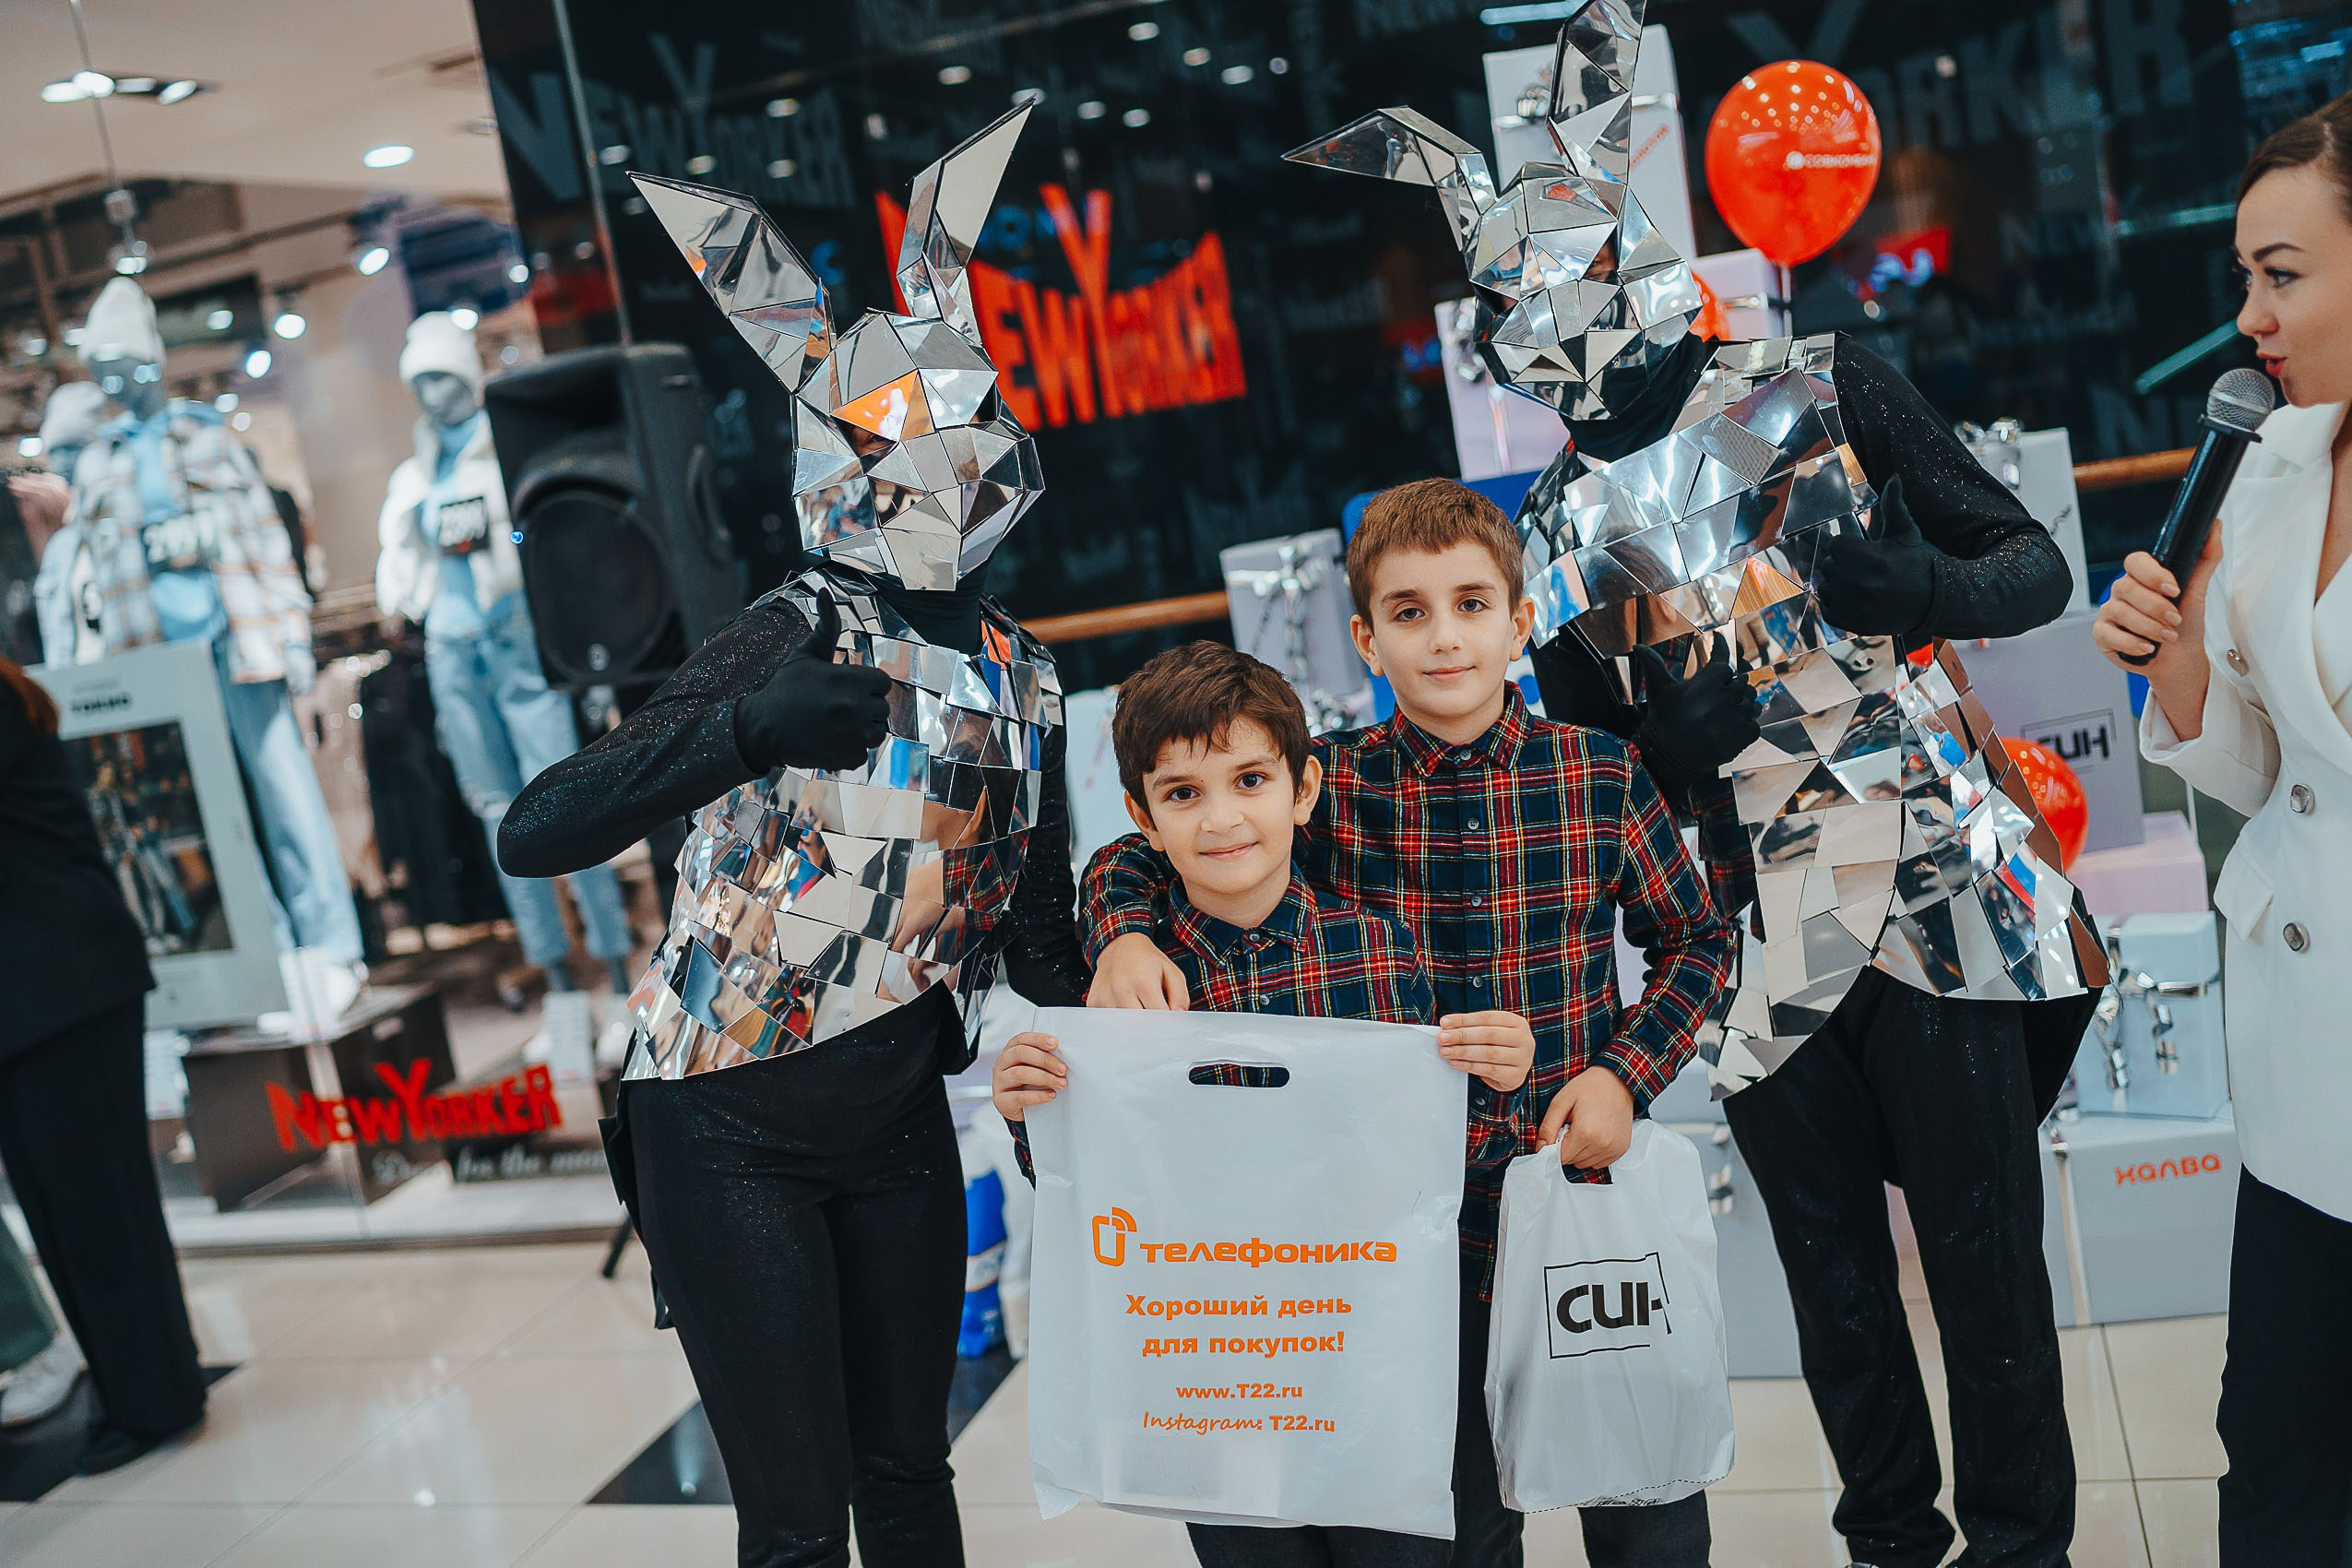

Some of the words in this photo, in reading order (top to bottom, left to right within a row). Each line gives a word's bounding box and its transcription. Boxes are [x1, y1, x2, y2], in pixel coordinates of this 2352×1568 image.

[1139, 1237, 1397, 1268] телефоника
[1125, 1293, 1268, 1321] Хороший
[1277, 1298, 1352, 1319] день
[1142, 1337, 1198, 1358] для
[1209, 1331, 1345, 1359] покупок!
[1176, 1383, 1303, 1399] www.T22.ru
[1143, 1410, 1263, 1436] Instagram:
[1268, 1415, 1336, 1432] T22.ru
